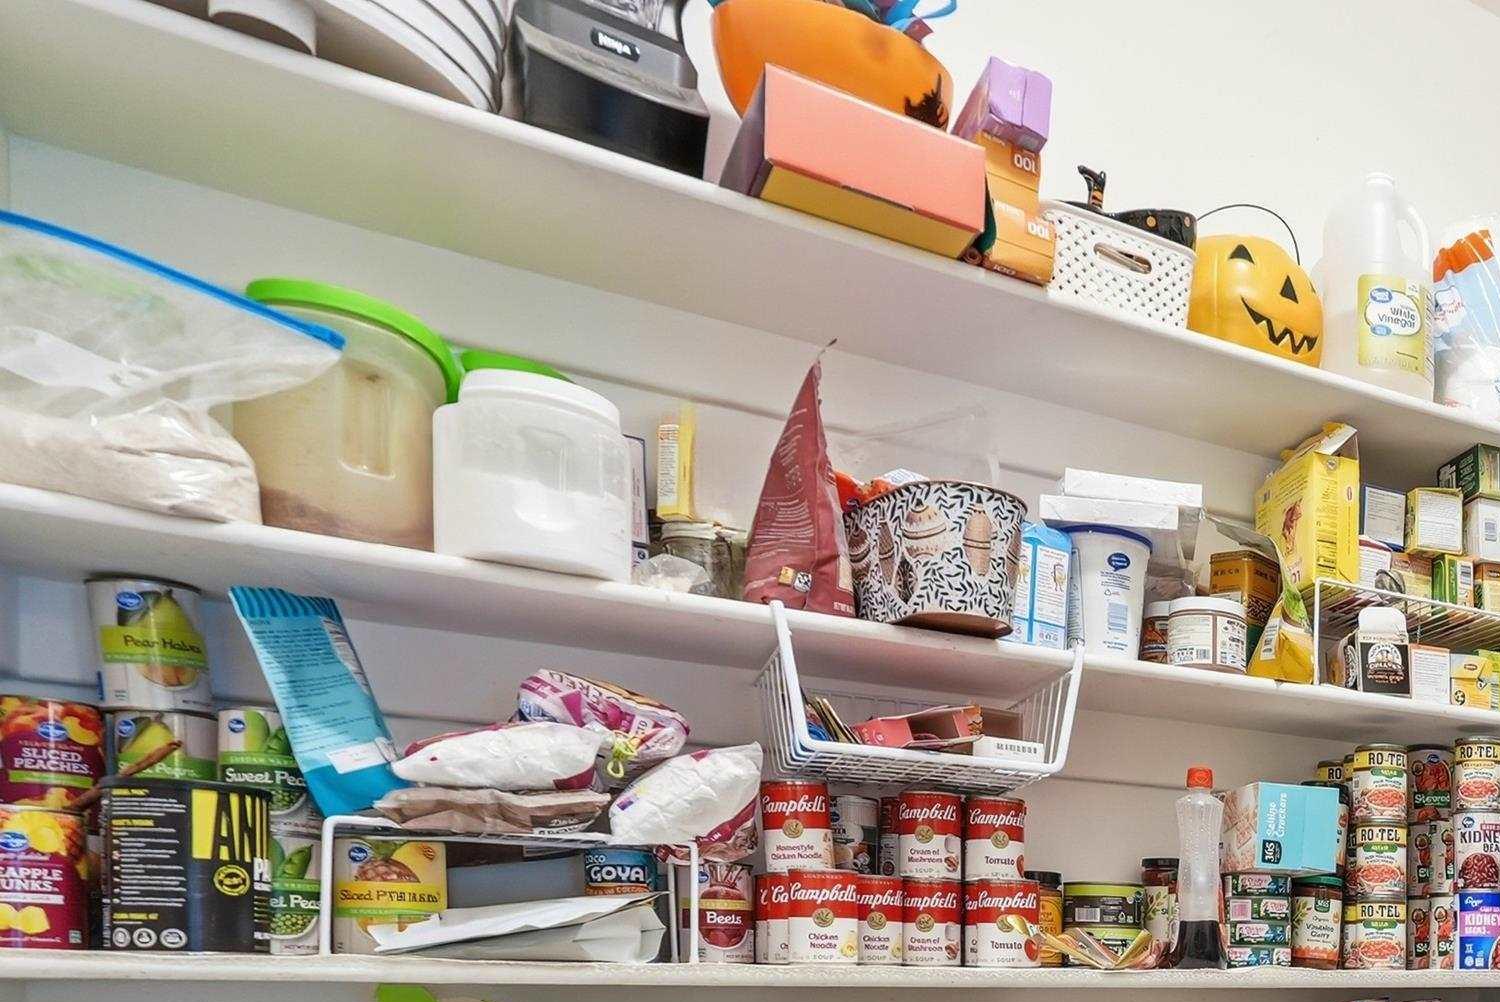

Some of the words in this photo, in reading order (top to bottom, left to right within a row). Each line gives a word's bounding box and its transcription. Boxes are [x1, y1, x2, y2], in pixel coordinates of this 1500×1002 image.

[21, 747, 81, 762] SLICED
[13, 757, 91, 773] PEACHES
[225, 768, 272, 784] Sweet
[275, 771, 304, 786] Pea
[985, 855, 1015, 866] Tomato
[589, 867, 645, 882] GOYA
[1465, 914, 1500, 927] KIDNEY
[808, 933, 838, 941] Chicken
[810, 941, 838, 949] Noodle
[990, 940, 1023, 950] Tomato
